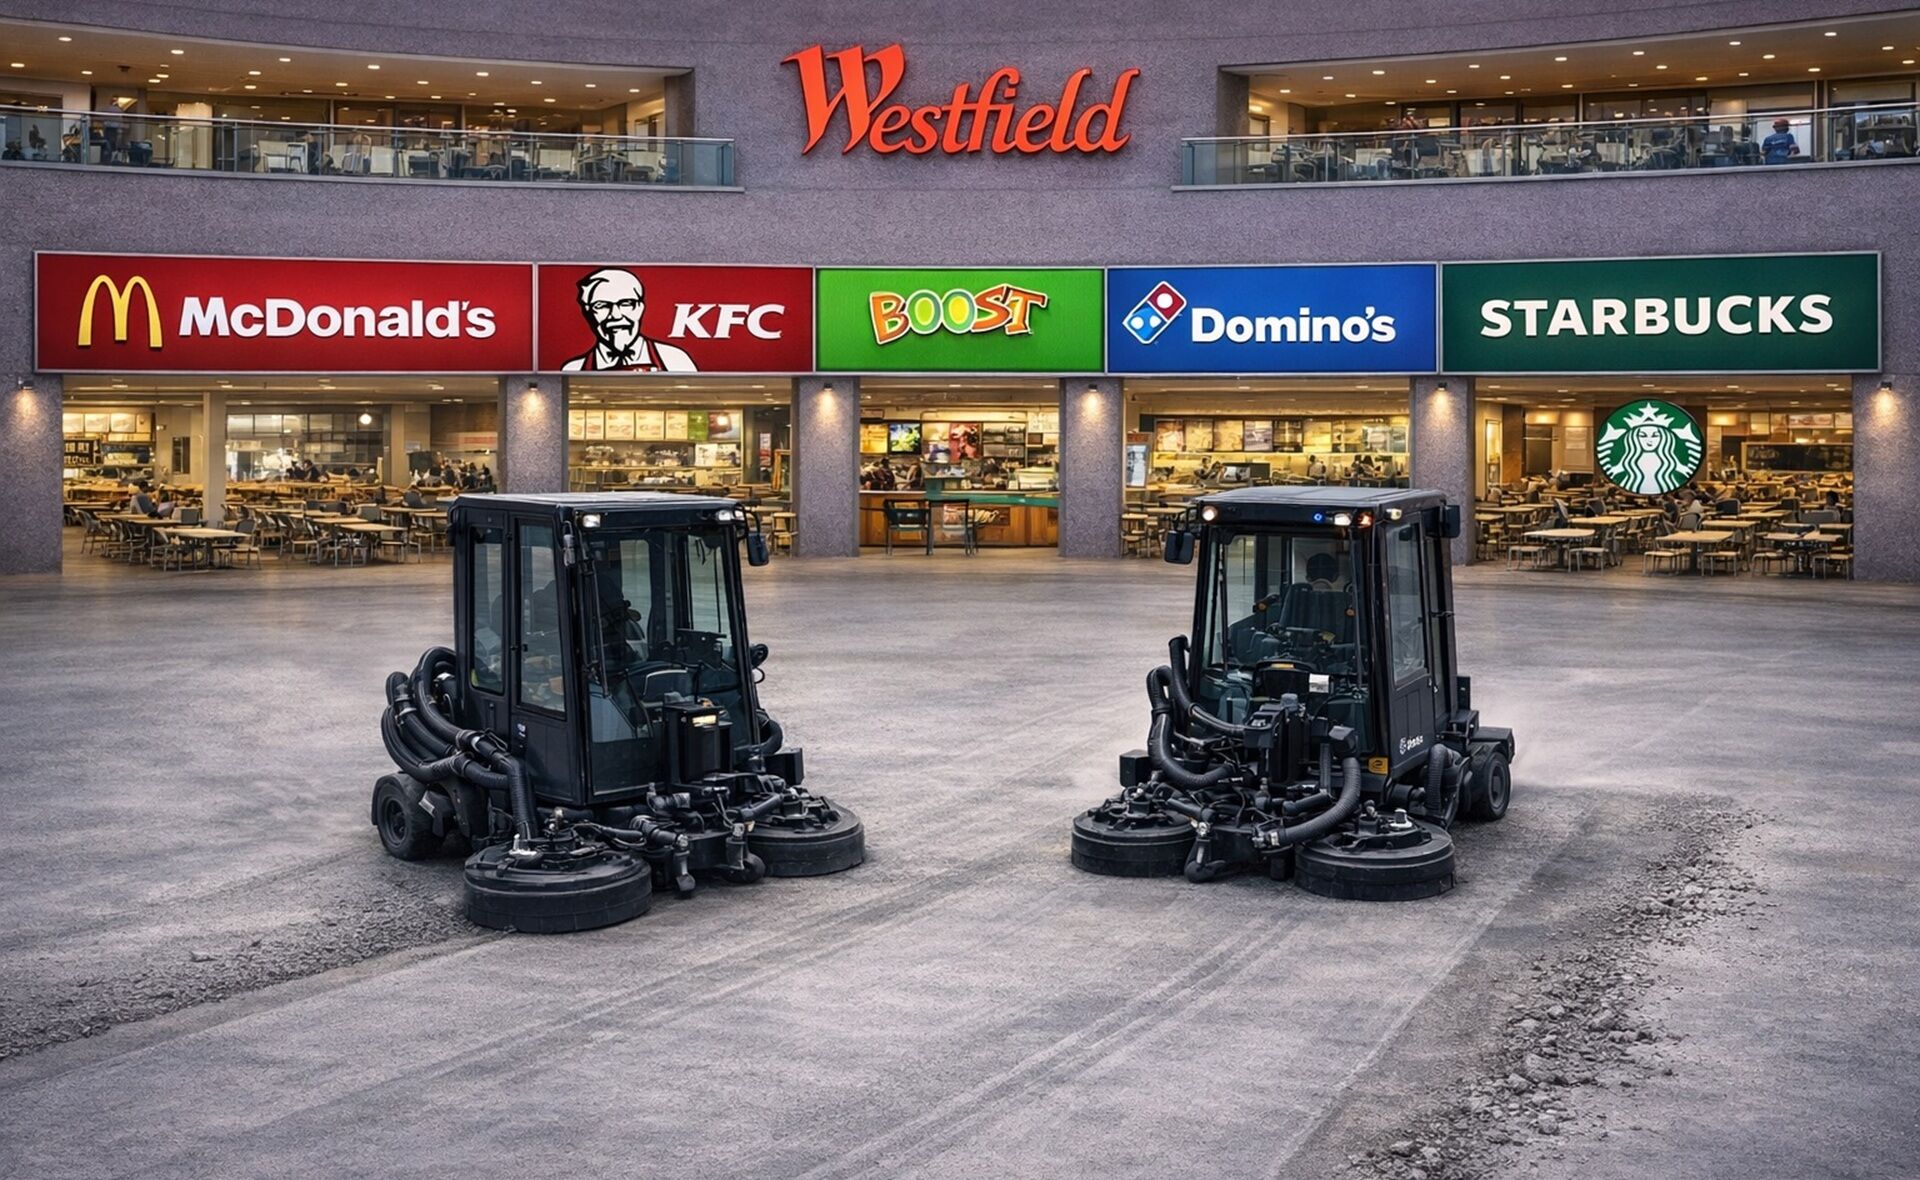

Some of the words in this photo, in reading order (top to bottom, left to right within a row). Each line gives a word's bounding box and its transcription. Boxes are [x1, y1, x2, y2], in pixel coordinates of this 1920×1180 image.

[781, 44, 1140, 154] Westfield
[179, 296, 496, 338] McDonald's
[668, 303, 785, 339] KFC
[870, 284, 1048, 345] BOOST
[1191, 306, 1397, 343] Domino's
[1480, 294, 1834, 337] STARBUCKS
